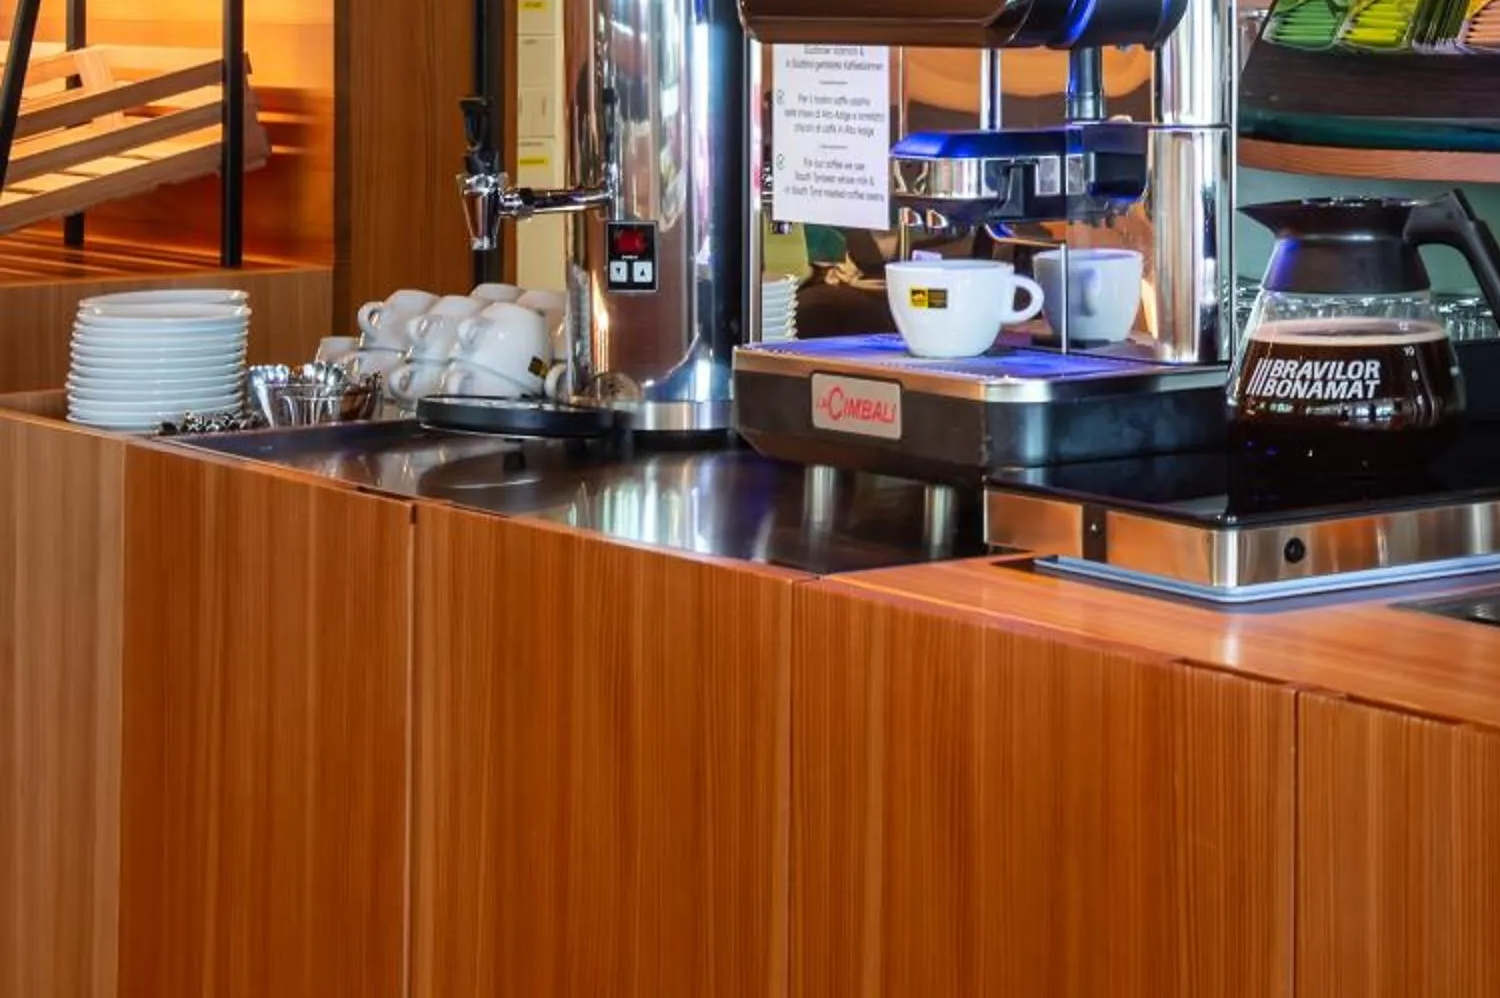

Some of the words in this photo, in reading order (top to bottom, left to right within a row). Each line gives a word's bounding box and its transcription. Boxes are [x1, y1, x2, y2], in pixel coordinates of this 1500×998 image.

[1403, 345, 1415, 357] 10
[1269, 359, 1381, 380] BRAVILOR
[1262, 379, 1381, 399] BONAMAT
[828, 387, 897, 424] CIMBALI
